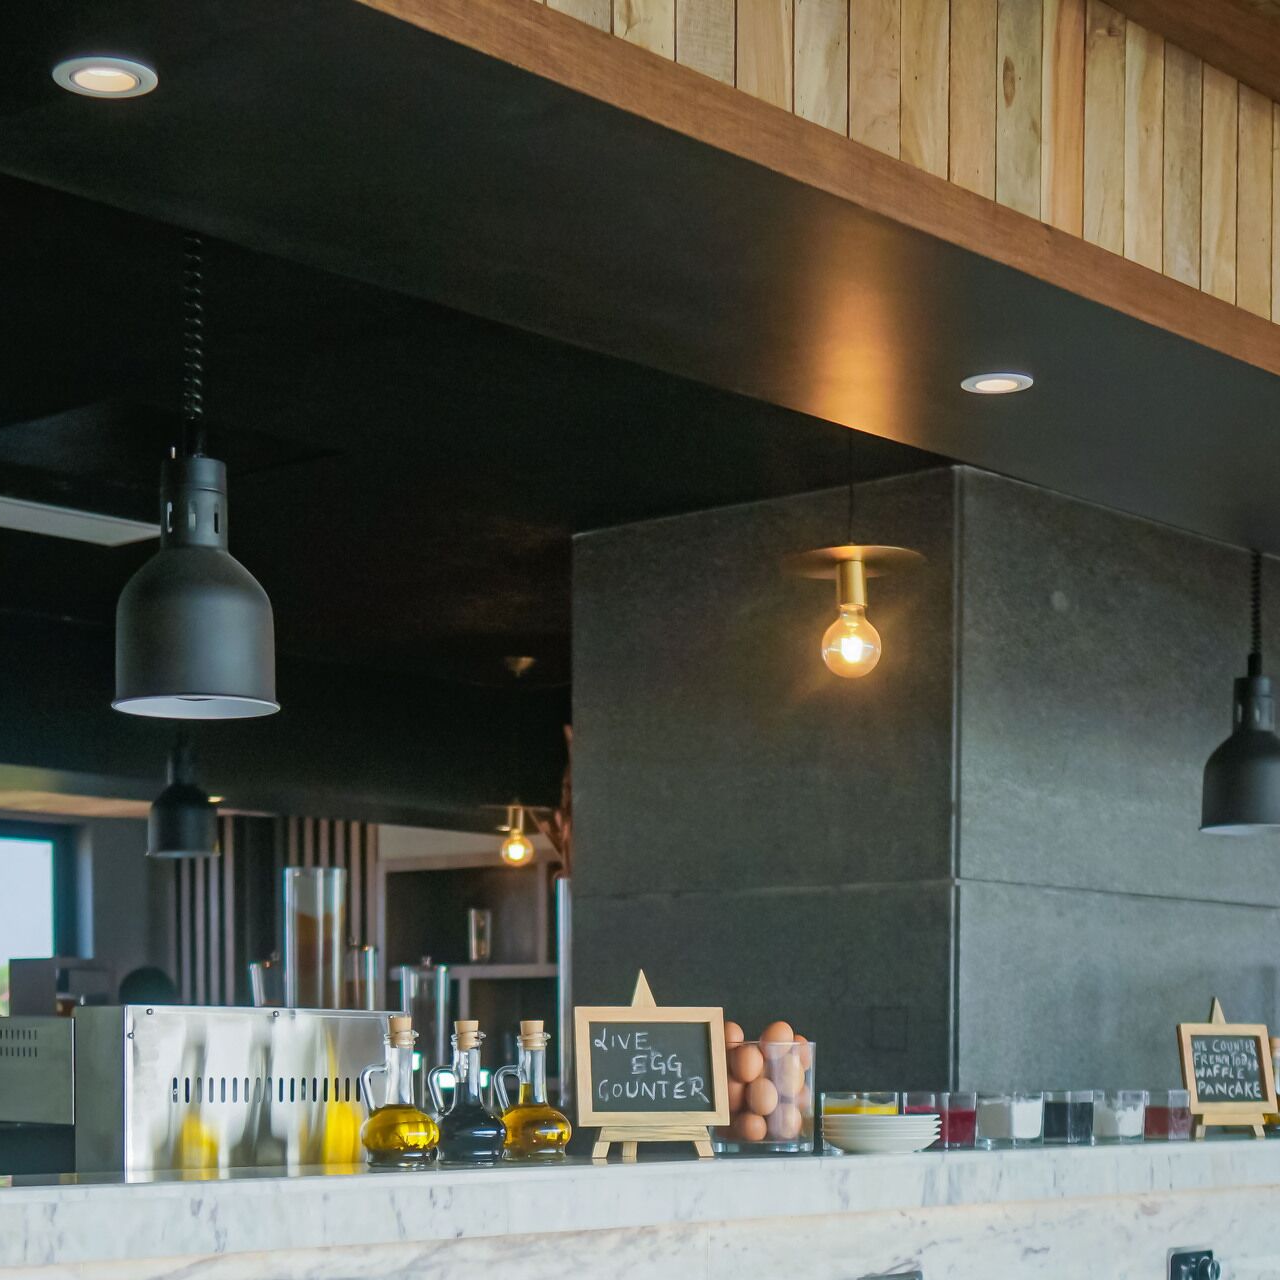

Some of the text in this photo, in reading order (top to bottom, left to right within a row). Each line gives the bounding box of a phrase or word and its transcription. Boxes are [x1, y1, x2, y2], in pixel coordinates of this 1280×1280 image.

[594, 1028, 651, 1051] LIVE
[631, 1053, 683, 1077] EGG
[1196, 1064, 1246, 1079] WAFFLE
[598, 1077, 711, 1104] COUNTER
[1197, 1081, 1262, 1099] PANCAKE
